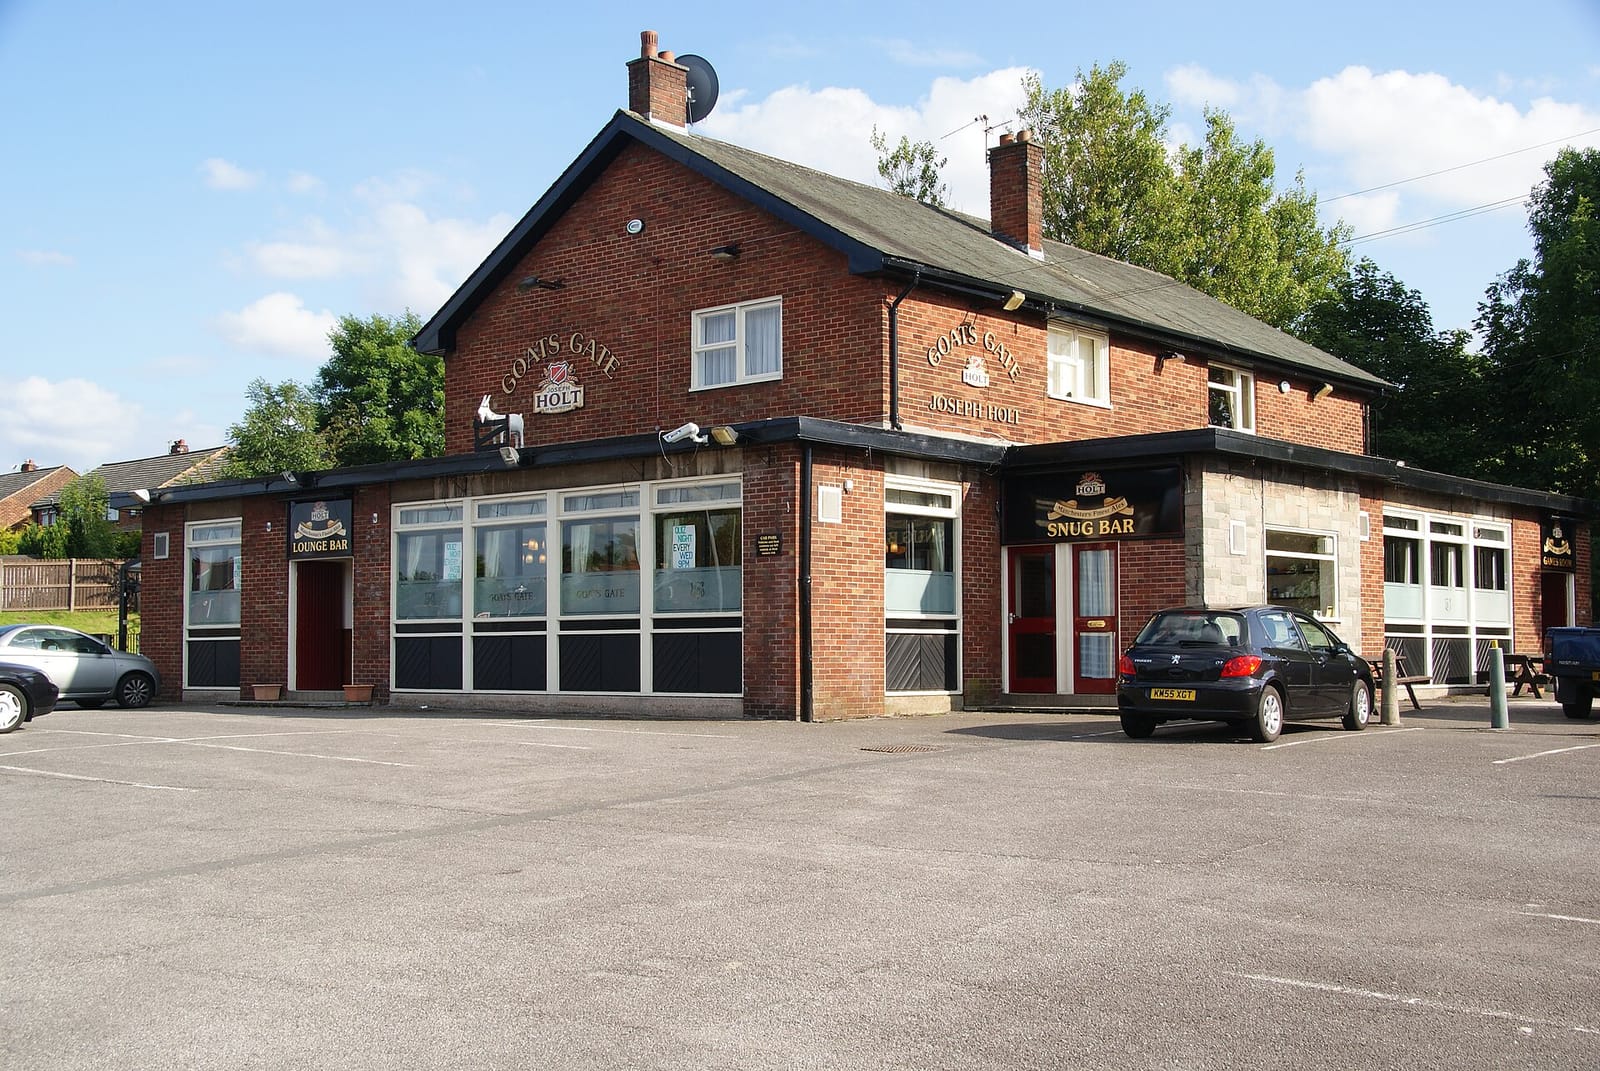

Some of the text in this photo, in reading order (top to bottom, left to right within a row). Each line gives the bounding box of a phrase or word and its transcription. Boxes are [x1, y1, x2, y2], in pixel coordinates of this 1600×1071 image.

[927, 325, 1022, 383] GOATS GATE
[502, 332, 620, 394] GOATS GATE
[965, 372, 988, 384] HOLT
[536, 390, 581, 408] HOLT
[928, 394, 1020, 424] JOSEPH HOLT
[1077, 484, 1104, 494] HOLT
[1047, 518, 1135, 537] SNUG BAR
[293, 539, 348, 553] LOUNGE BAR
[673, 543, 690, 551] EVERY
[679, 551, 693, 560] WED
[1176, 690, 1192, 699] XGT
